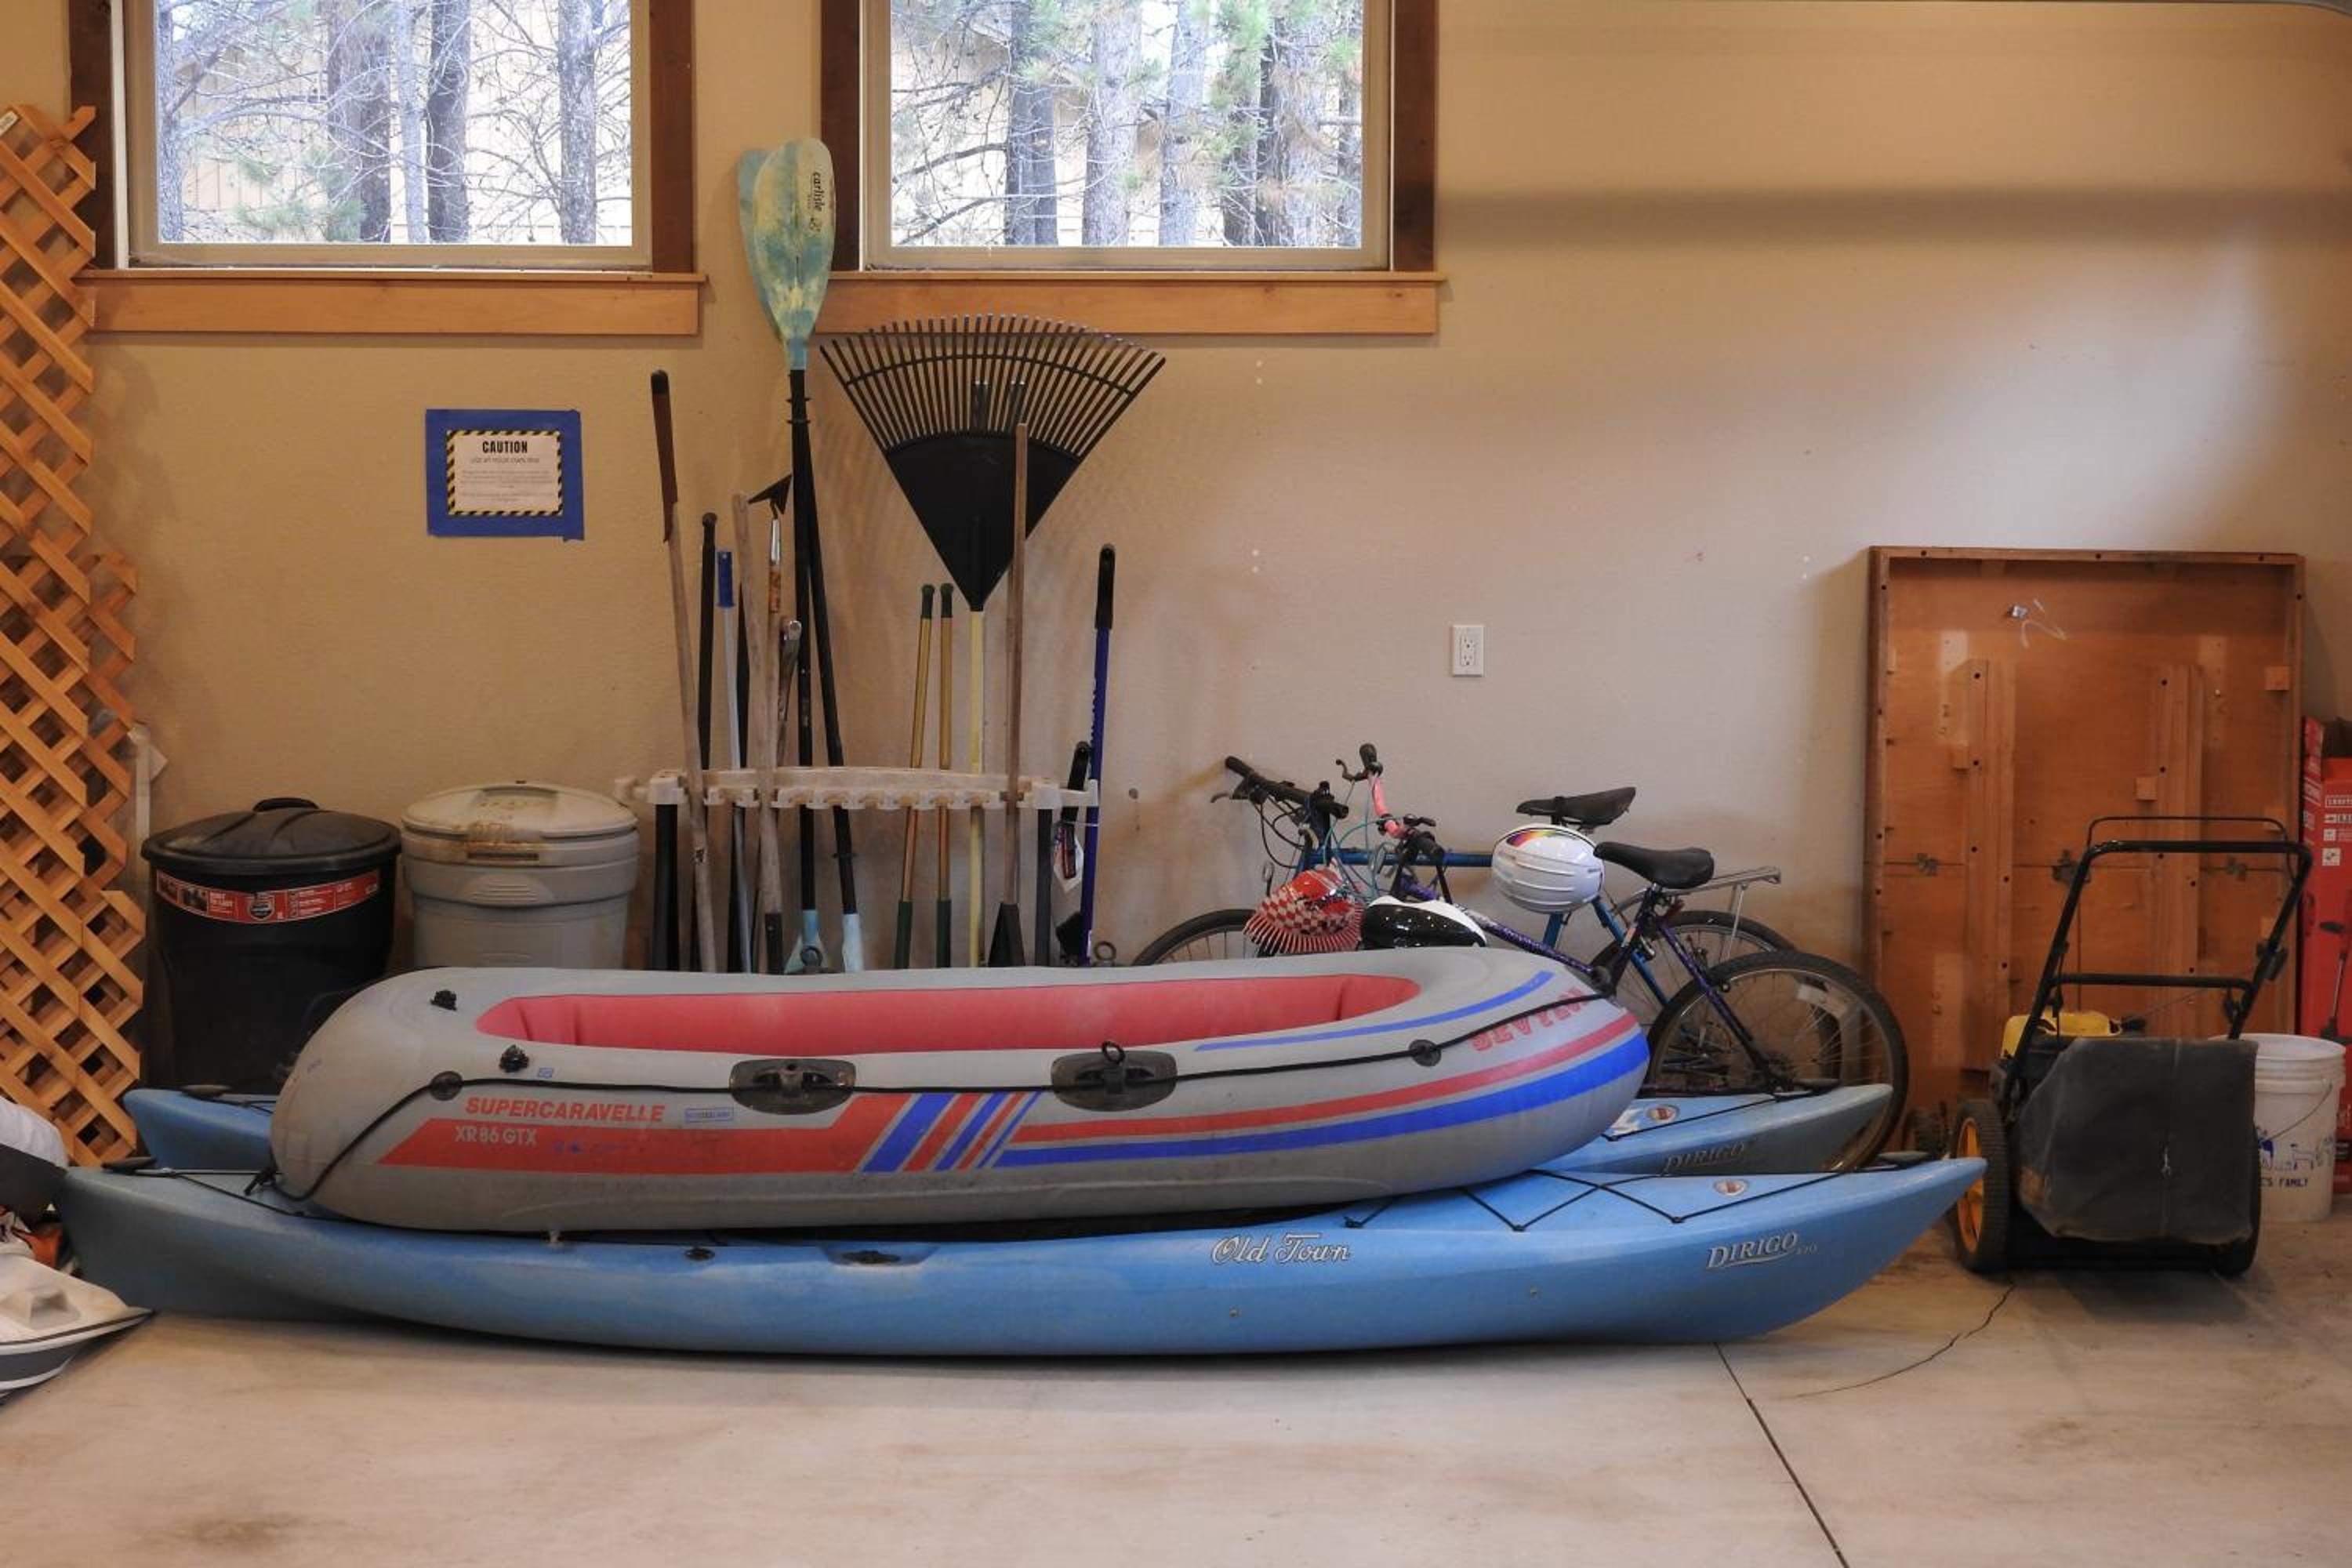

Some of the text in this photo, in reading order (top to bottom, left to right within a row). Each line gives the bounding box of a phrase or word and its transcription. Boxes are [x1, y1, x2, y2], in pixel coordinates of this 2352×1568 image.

[812, 171, 826, 212] carlisle
[482, 440, 528, 454] CAUTION
[465, 1097, 666, 1123] SUPERCARAVELLE
[1211, 1232, 1351, 1266] Old Town
[1706, 1231, 1798, 1269] DIRIGO
